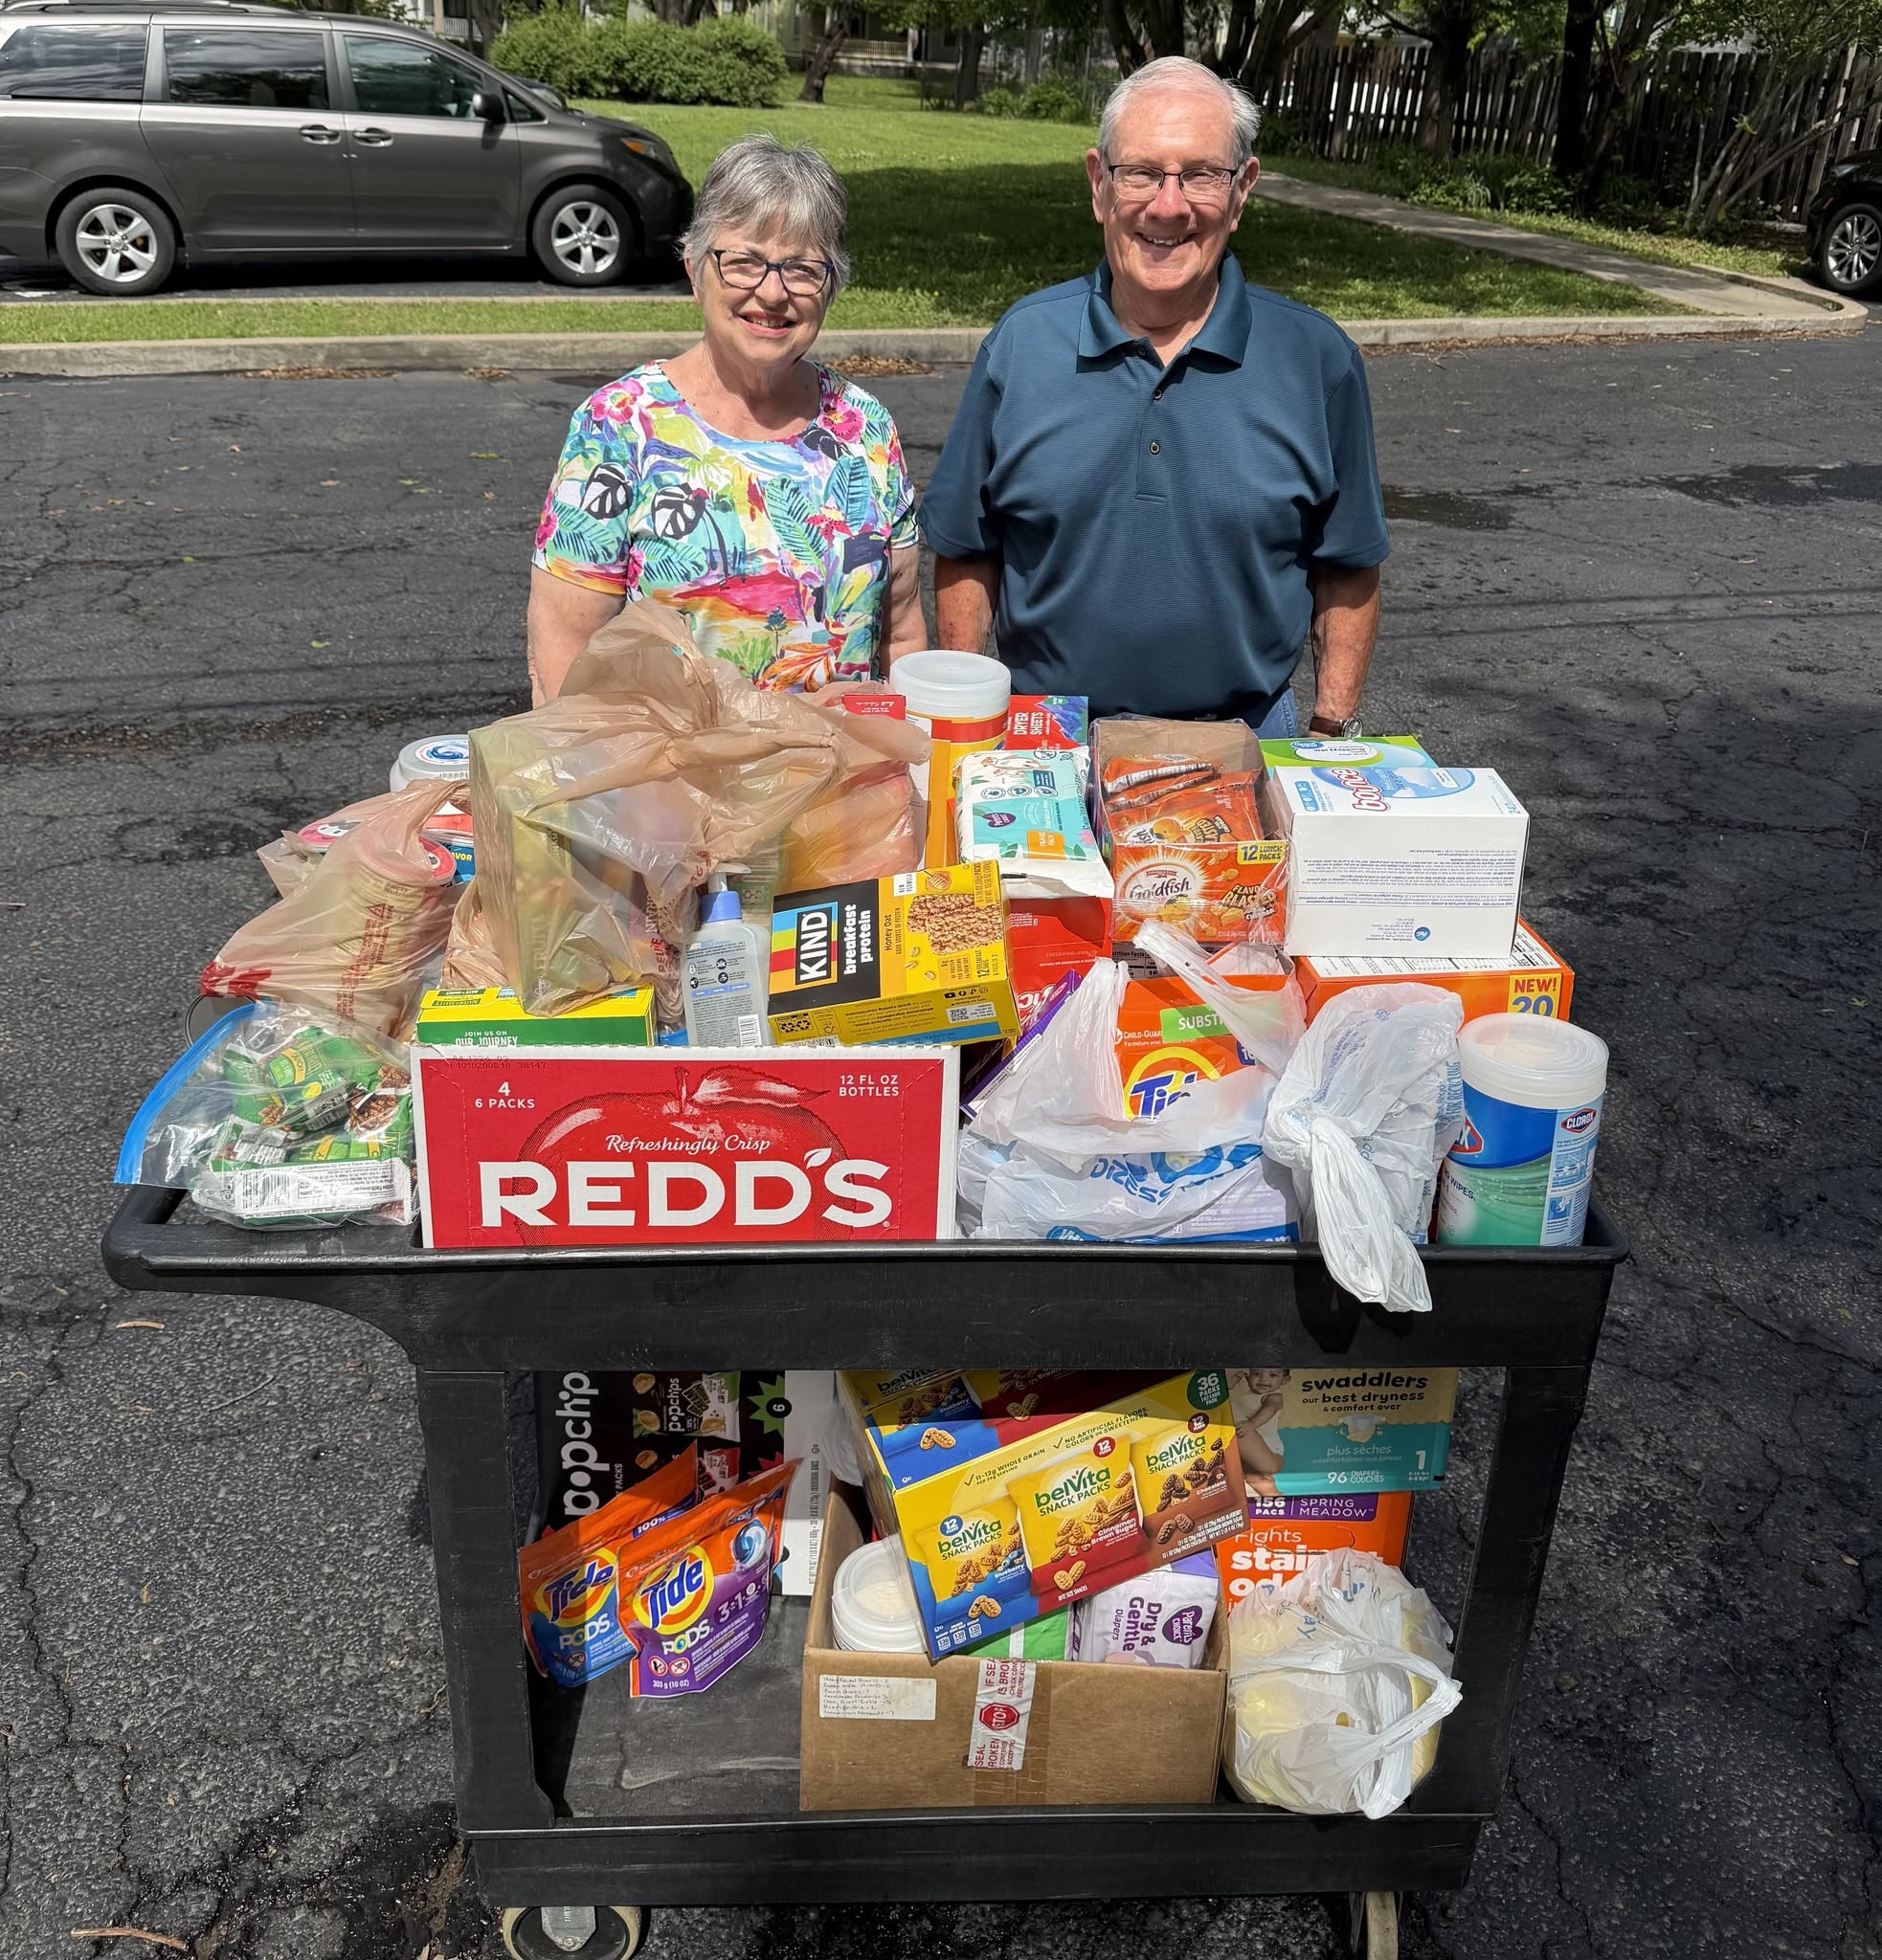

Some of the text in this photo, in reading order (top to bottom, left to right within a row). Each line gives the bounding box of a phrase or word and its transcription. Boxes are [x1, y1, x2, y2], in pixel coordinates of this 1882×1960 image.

[1013, 712, 1029, 735] DRYER
[1030, 711, 1043, 735] SHEETS
[1332, 768, 1388, 812] bounce
[1241, 844, 1259, 861] 12
[1259, 853, 1282, 861] PACKS
[1130, 877, 1190, 901] Goldfish
[843, 903, 857, 975] breakfast
[859, 909, 873, 963] protein
[884, 914, 892, 951] Honey Oat
[799, 911, 828, 981] KIND
[977, 969, 990, 978] 12
[1513, 978, 1557, 993] NEW!
[1512, 996, 1554, 1017] 20
[456, 1036, 518, 1046] OUR JOURNEY
[498, 1081, 511, 1096] 4
[840, 1074, 899, 1085] 12 FL OZ
[839, 1085, 900, 1098] BOTTLES
[475, 1098, 535, 1109] 6 PACKS
[1566, 1112, 1594, 1128] CLOROX
[606, 1134, 771, 1154] Refreshingly Crisp
[478, 1148, 894, 1229] REDD'S
[1197, 1373, 1220, 1391] 36
[1199, 1385, 1221, 1397] PACKS
[1302, 1371, 1429, 1392] swaddlers
[666, 1377, 685, 1433] popchips
[939, 1398, 971, 1414] Blueberry
[1322, 1392, 1356, 1404] best
[1361, 1392, 1424, 1404] dryness
[1331, 1403, 1375, 1413] comfort
[773, 1403, 786, 1414] 6
[1064, 1407, 1149, 1444] NO ARTIFICIAL FLAVORS,
[1065, 1413, 1149, 1449] COLORS SWEETENERS
[1192, 1415, 1204, 1427] 12
[1097, 1439, 1110, 1451] 12
[1146, 1434, 1206, 1468] belVita
[1327, 1444, 1392, 1458] plus sèches
[975, 1448, 1045, 1481] 11-12g WHOLE GRAIN
[1149, 1447, 1206, 1475] SNACK PACKS
[1318, 1455, 1362, 1463] confortables
[1378, 1455, 1401, 1463] jamais
[1416, 1450, 1426, 1470] 1
[614, 1462, 623, 1490] PACKS
[1327, 1472, 1347, 1484] 96
[1350, 1476, 1384, 1484] COUCHES
[1035, 1466, 1110, 1508] belVita
[1197, 1480, 1226, 1495] Chocolate
[1040, 1481, 1110, 1517] SNACK PACKS
[1255, 1497, 1286, 1508] 156
[1300, 1498, 1355, 1507] SPRING
[1300, 1507, 1367, 1518] MEADOW
[637, 1514, 666, 1533] 100%
[944, 1518, 957, 1530] 12
[1098, 1517, 1136, 1537] Cinnamon
[938, 1520, 1002, 1554] belVita
[1091, 1531, 1114, 1545] Brown
[1115, 1523, 1137, 1537] Sugar
[1235, 1527, 1302, 1548] Fights
[942, 1531, 1002, 1561] SNACK PACKS
[994, 1563, 1024, 1579] Blueberry
[543, 1561, 616, 1624] Tide
[640, 1556, 705, 1629] Tide
[1074, 1585, 1088, 1596] SNACKS
[559, 1614, 611, 1651] PODS
[1111, 1609, 1124, 1641] Diapers
[1121, 1596, 1145, 1652] Gentle
[1140, 1601, 1163, 1647] Dry &
[1172, 1617, 1182, 1641] CHOICE
[1183, 1611, 1195, 1643] Parent's
[661, 1620, 711, 1655] PODS
[678, 1679, 690, 1688] OZ)
[985, 1679, 995, 1687] IF
[997, 1686, 1007, 1696] IS
[992, 1707, 1007, 1727] STOP
[975, 1744, 986, 1767] SEAL
